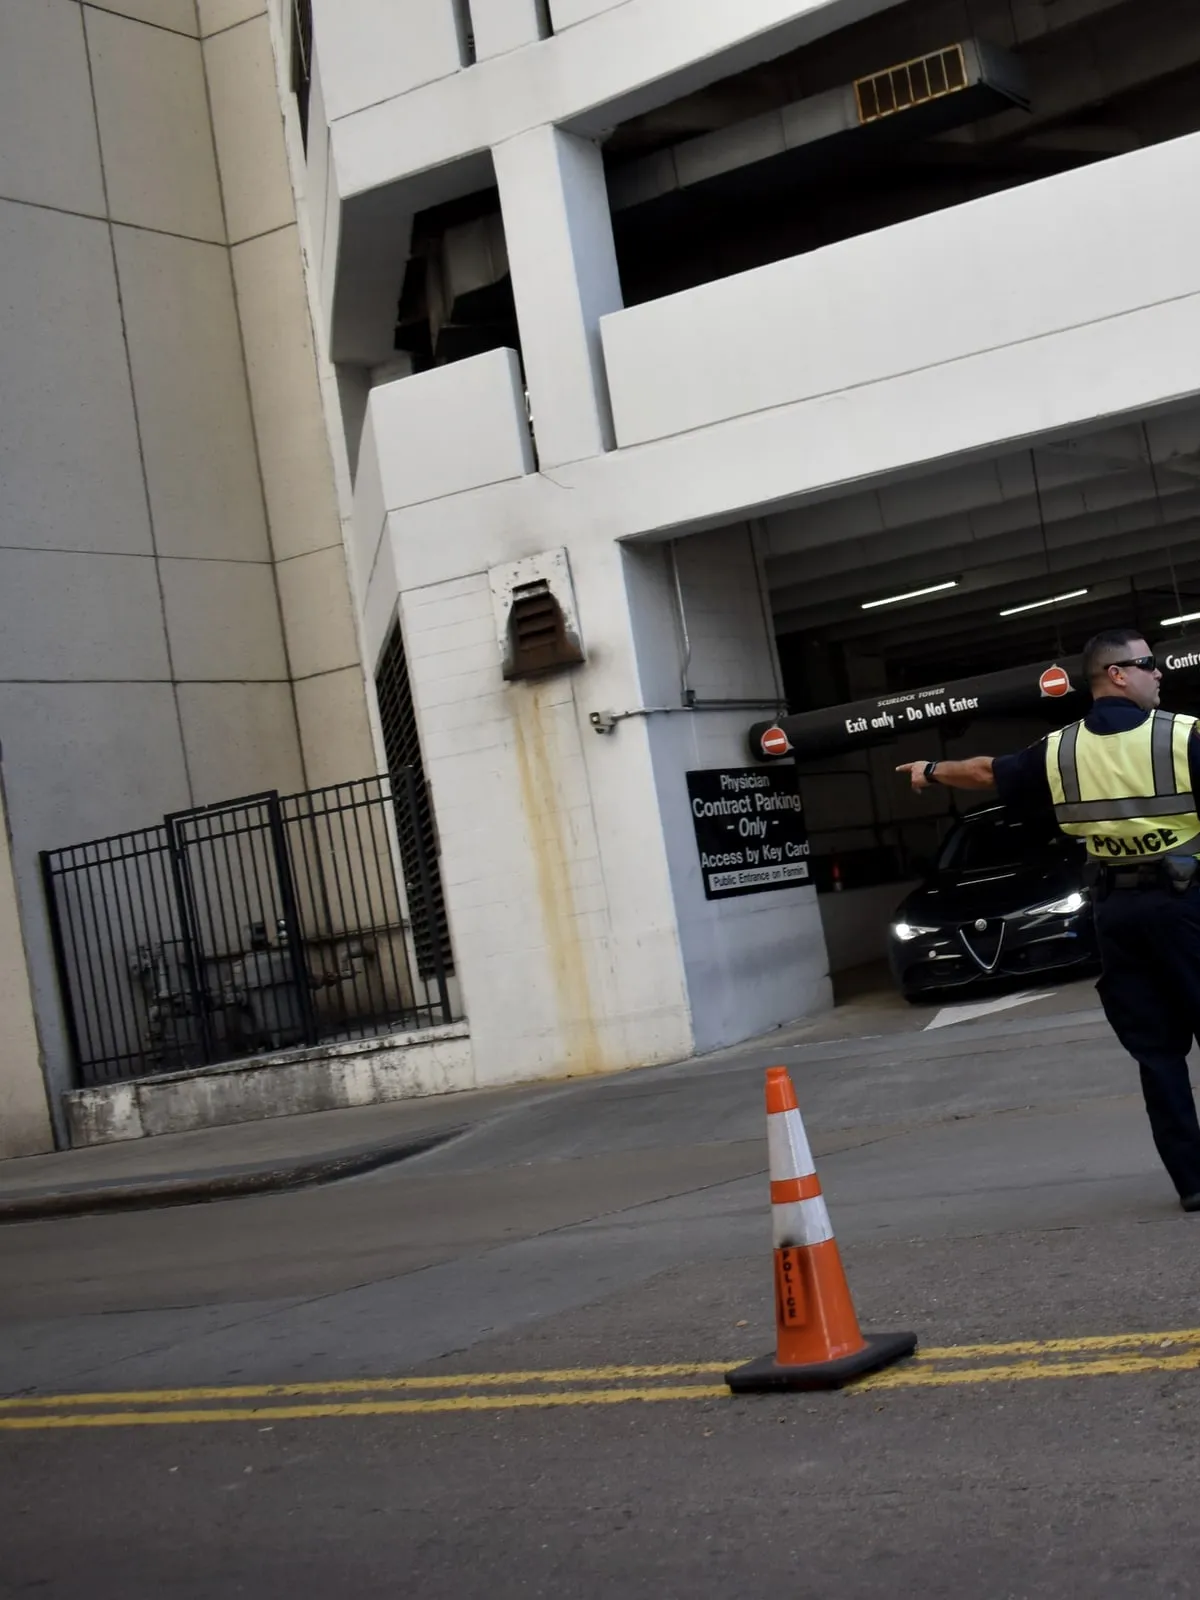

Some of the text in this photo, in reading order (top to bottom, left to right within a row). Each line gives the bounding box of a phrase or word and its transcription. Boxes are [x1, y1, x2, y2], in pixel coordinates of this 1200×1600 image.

[877, 687, 945, 707] SCURLOCK TOWER
[845, 717, 868, 733] Exit
[871, 711, 895, 729] only
[906, 707, 923, 721] Do
[924, 702, 947, 717] Not
[948, 697, 979, 712] Enter
[720, 773, 770, 792] Physician
[692, 792, 802, 818] Contract Parking
[739, 816, 767, 838] Only
[701, 840, 810, 868] Access by Key Card
[1092, 828, 1178, 856] POLICE
[713, 875, 737, 888] Public
[739, 871, 770, 884] Entrance
[772, 869, 781, 879] on
[782, 1250, 797, 1318] POLICE
